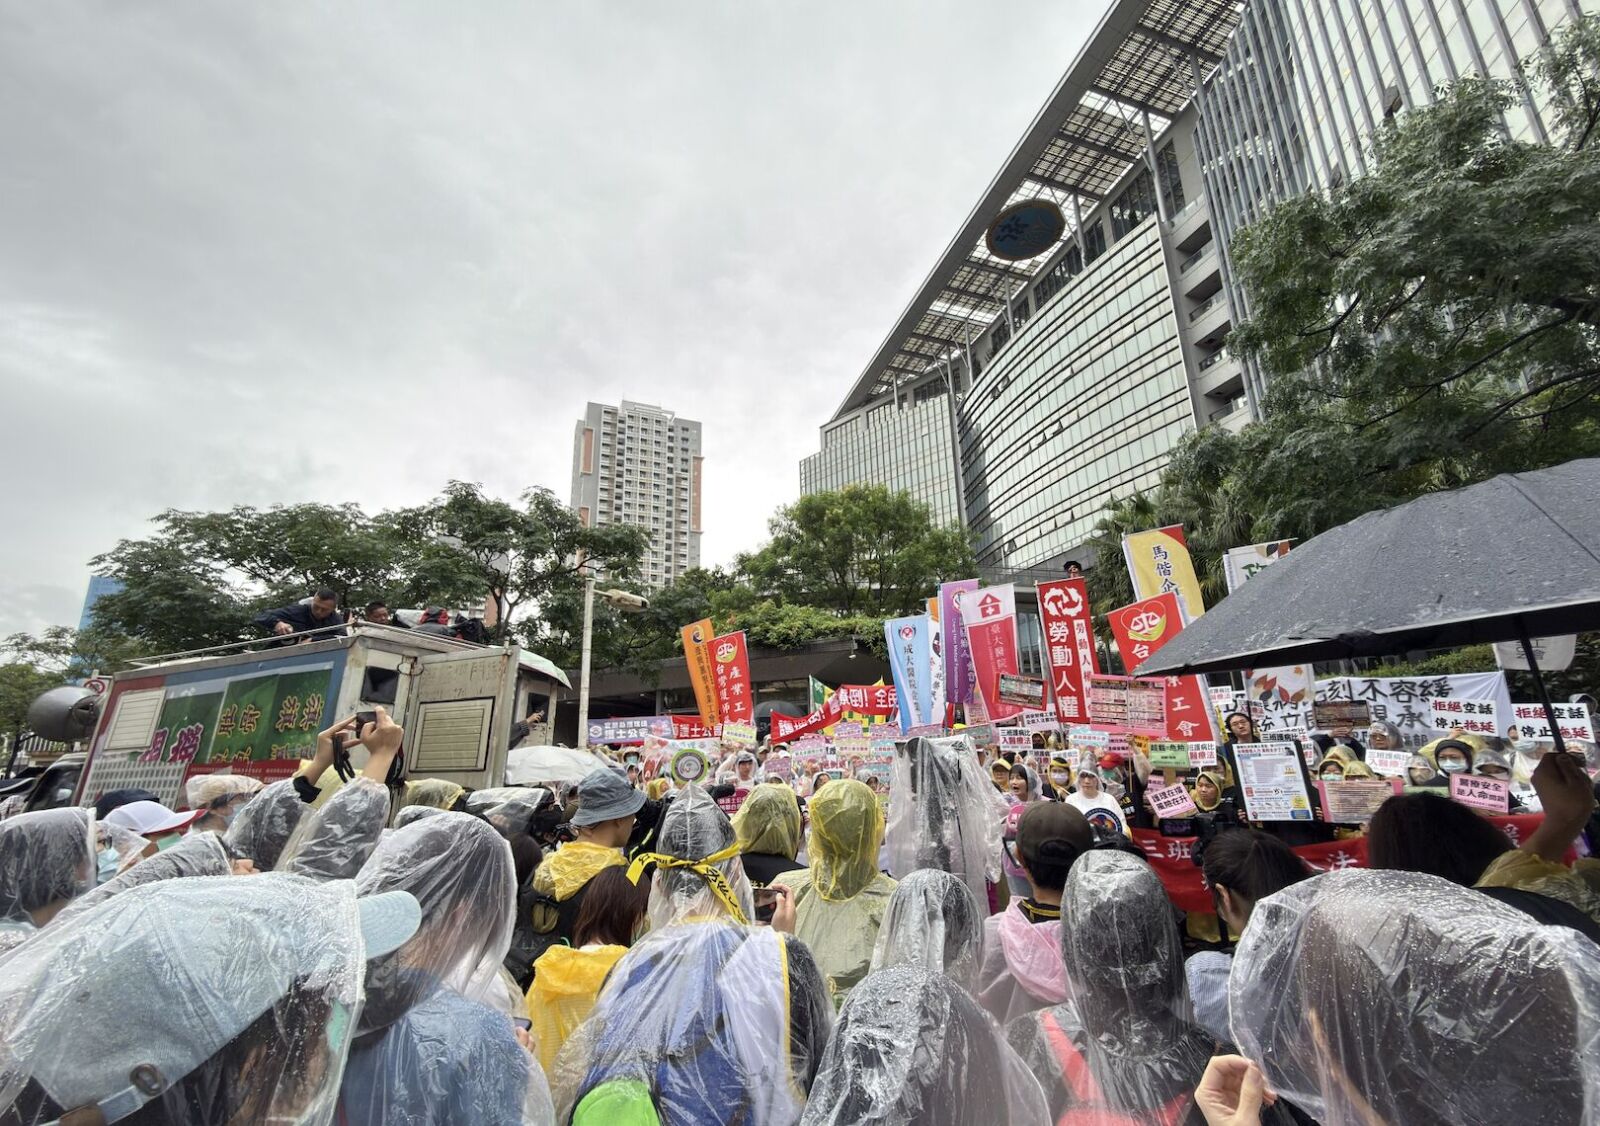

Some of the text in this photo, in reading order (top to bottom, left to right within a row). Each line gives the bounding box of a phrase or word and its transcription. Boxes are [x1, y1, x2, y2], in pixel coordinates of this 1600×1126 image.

[1048, 621, 1080, 717] 勞動人權
[1432, 700, 1494, 715] 拒絕空話
[1515, 707, 1586, 719] 拒絕空話
[1434, 717, 1496, 734] 停止拖延
[1000, 729, 1031, 737] 三班護病比
[1262, 732, 1299, 741] 三班護病比
[1001, 737, 1032, 745] 入醫療法
[1459, 778, 1502, 790] 醫療安全
[1142, 840, 1192, 861] 三班
